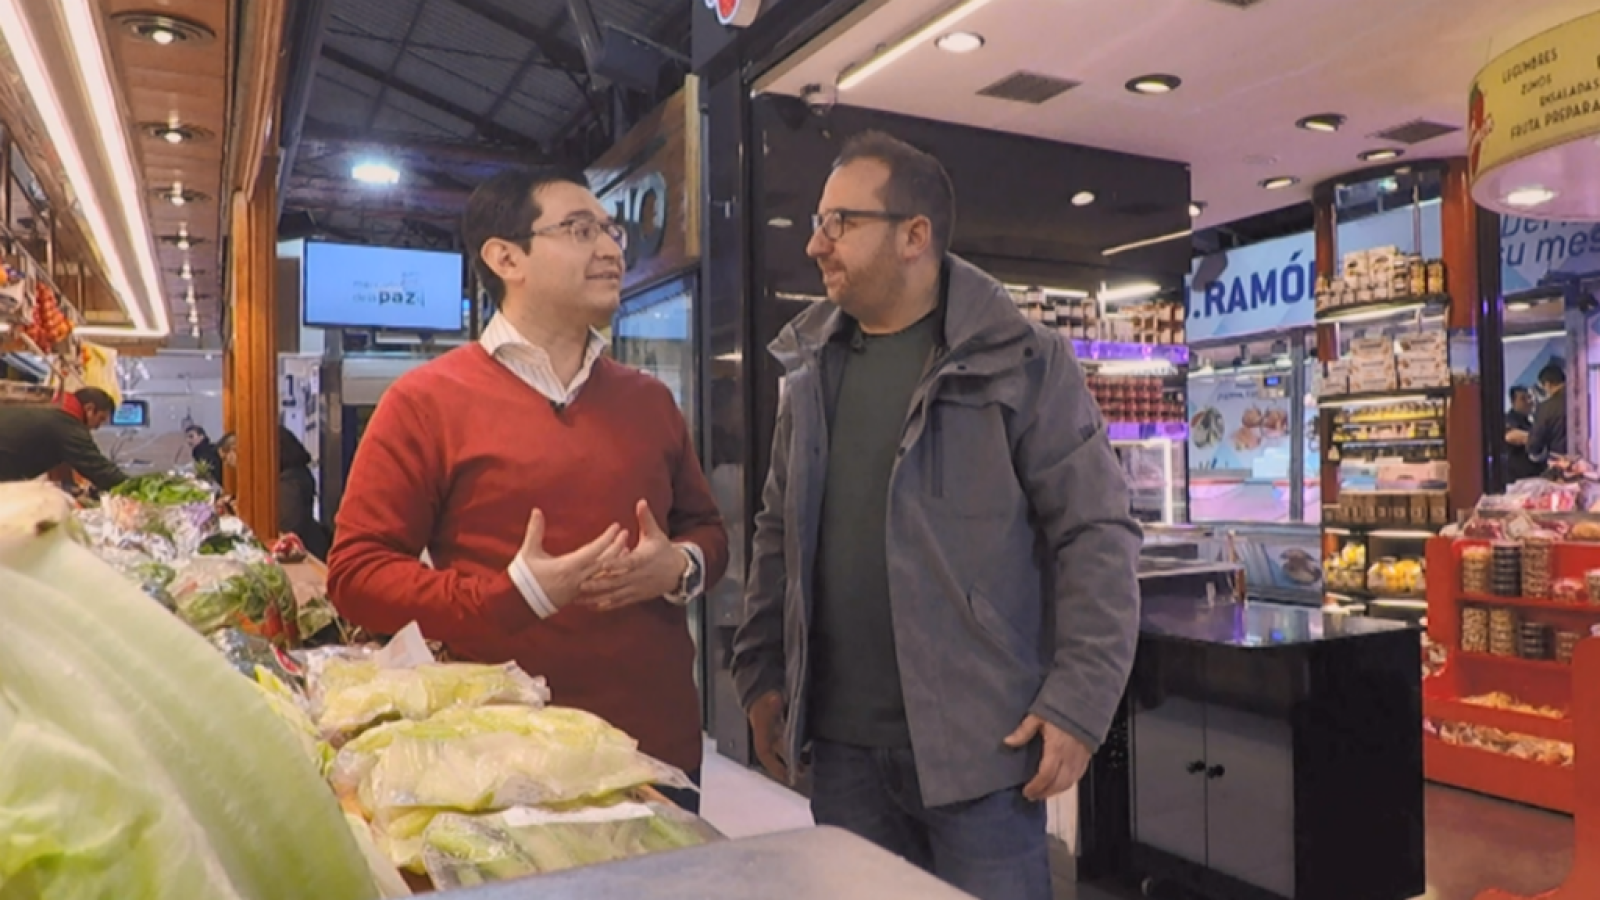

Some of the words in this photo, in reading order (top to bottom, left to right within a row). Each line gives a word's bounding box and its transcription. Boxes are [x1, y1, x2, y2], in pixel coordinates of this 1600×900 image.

[1502, 47, 1558, 84] LEGUMBRES
[1510, 117, 1541, 140] FRUTA
[379, 291, 416, 306] paz
